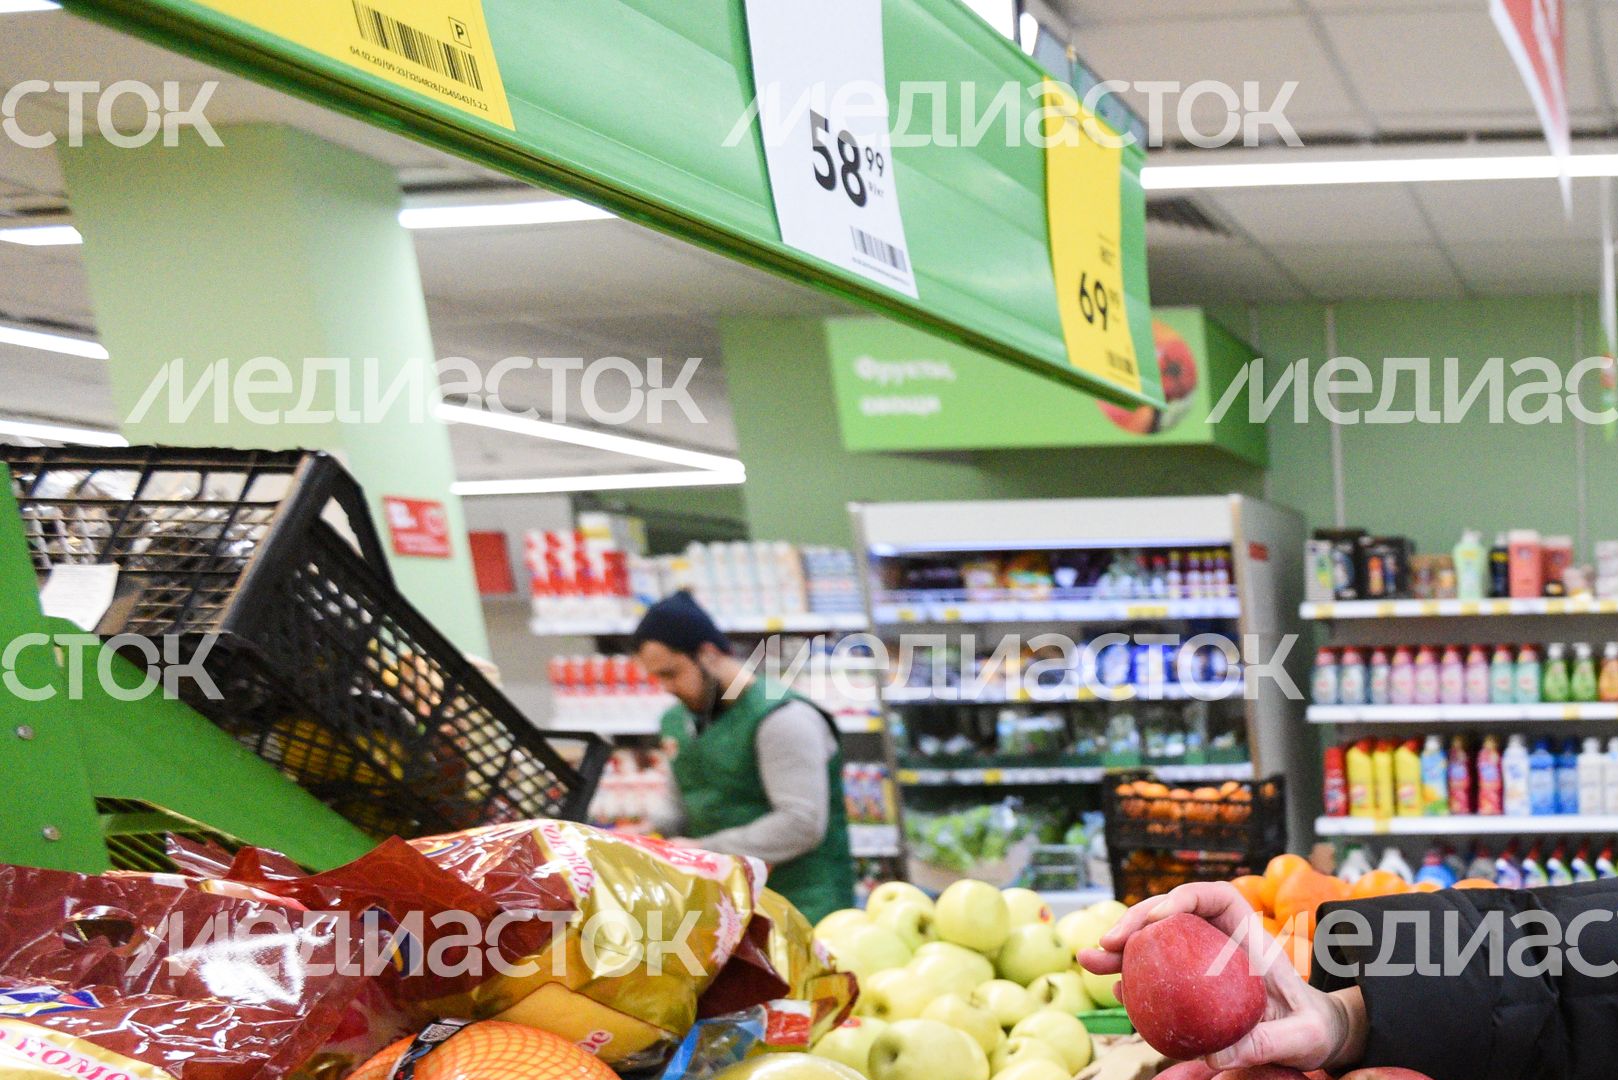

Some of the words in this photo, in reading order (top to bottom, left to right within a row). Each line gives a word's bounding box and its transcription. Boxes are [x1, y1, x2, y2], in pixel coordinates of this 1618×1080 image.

[810, 109, 867, 208] 58
[865, 146, 885, 178] 99
[1079, 272, 1108, 332] 69
